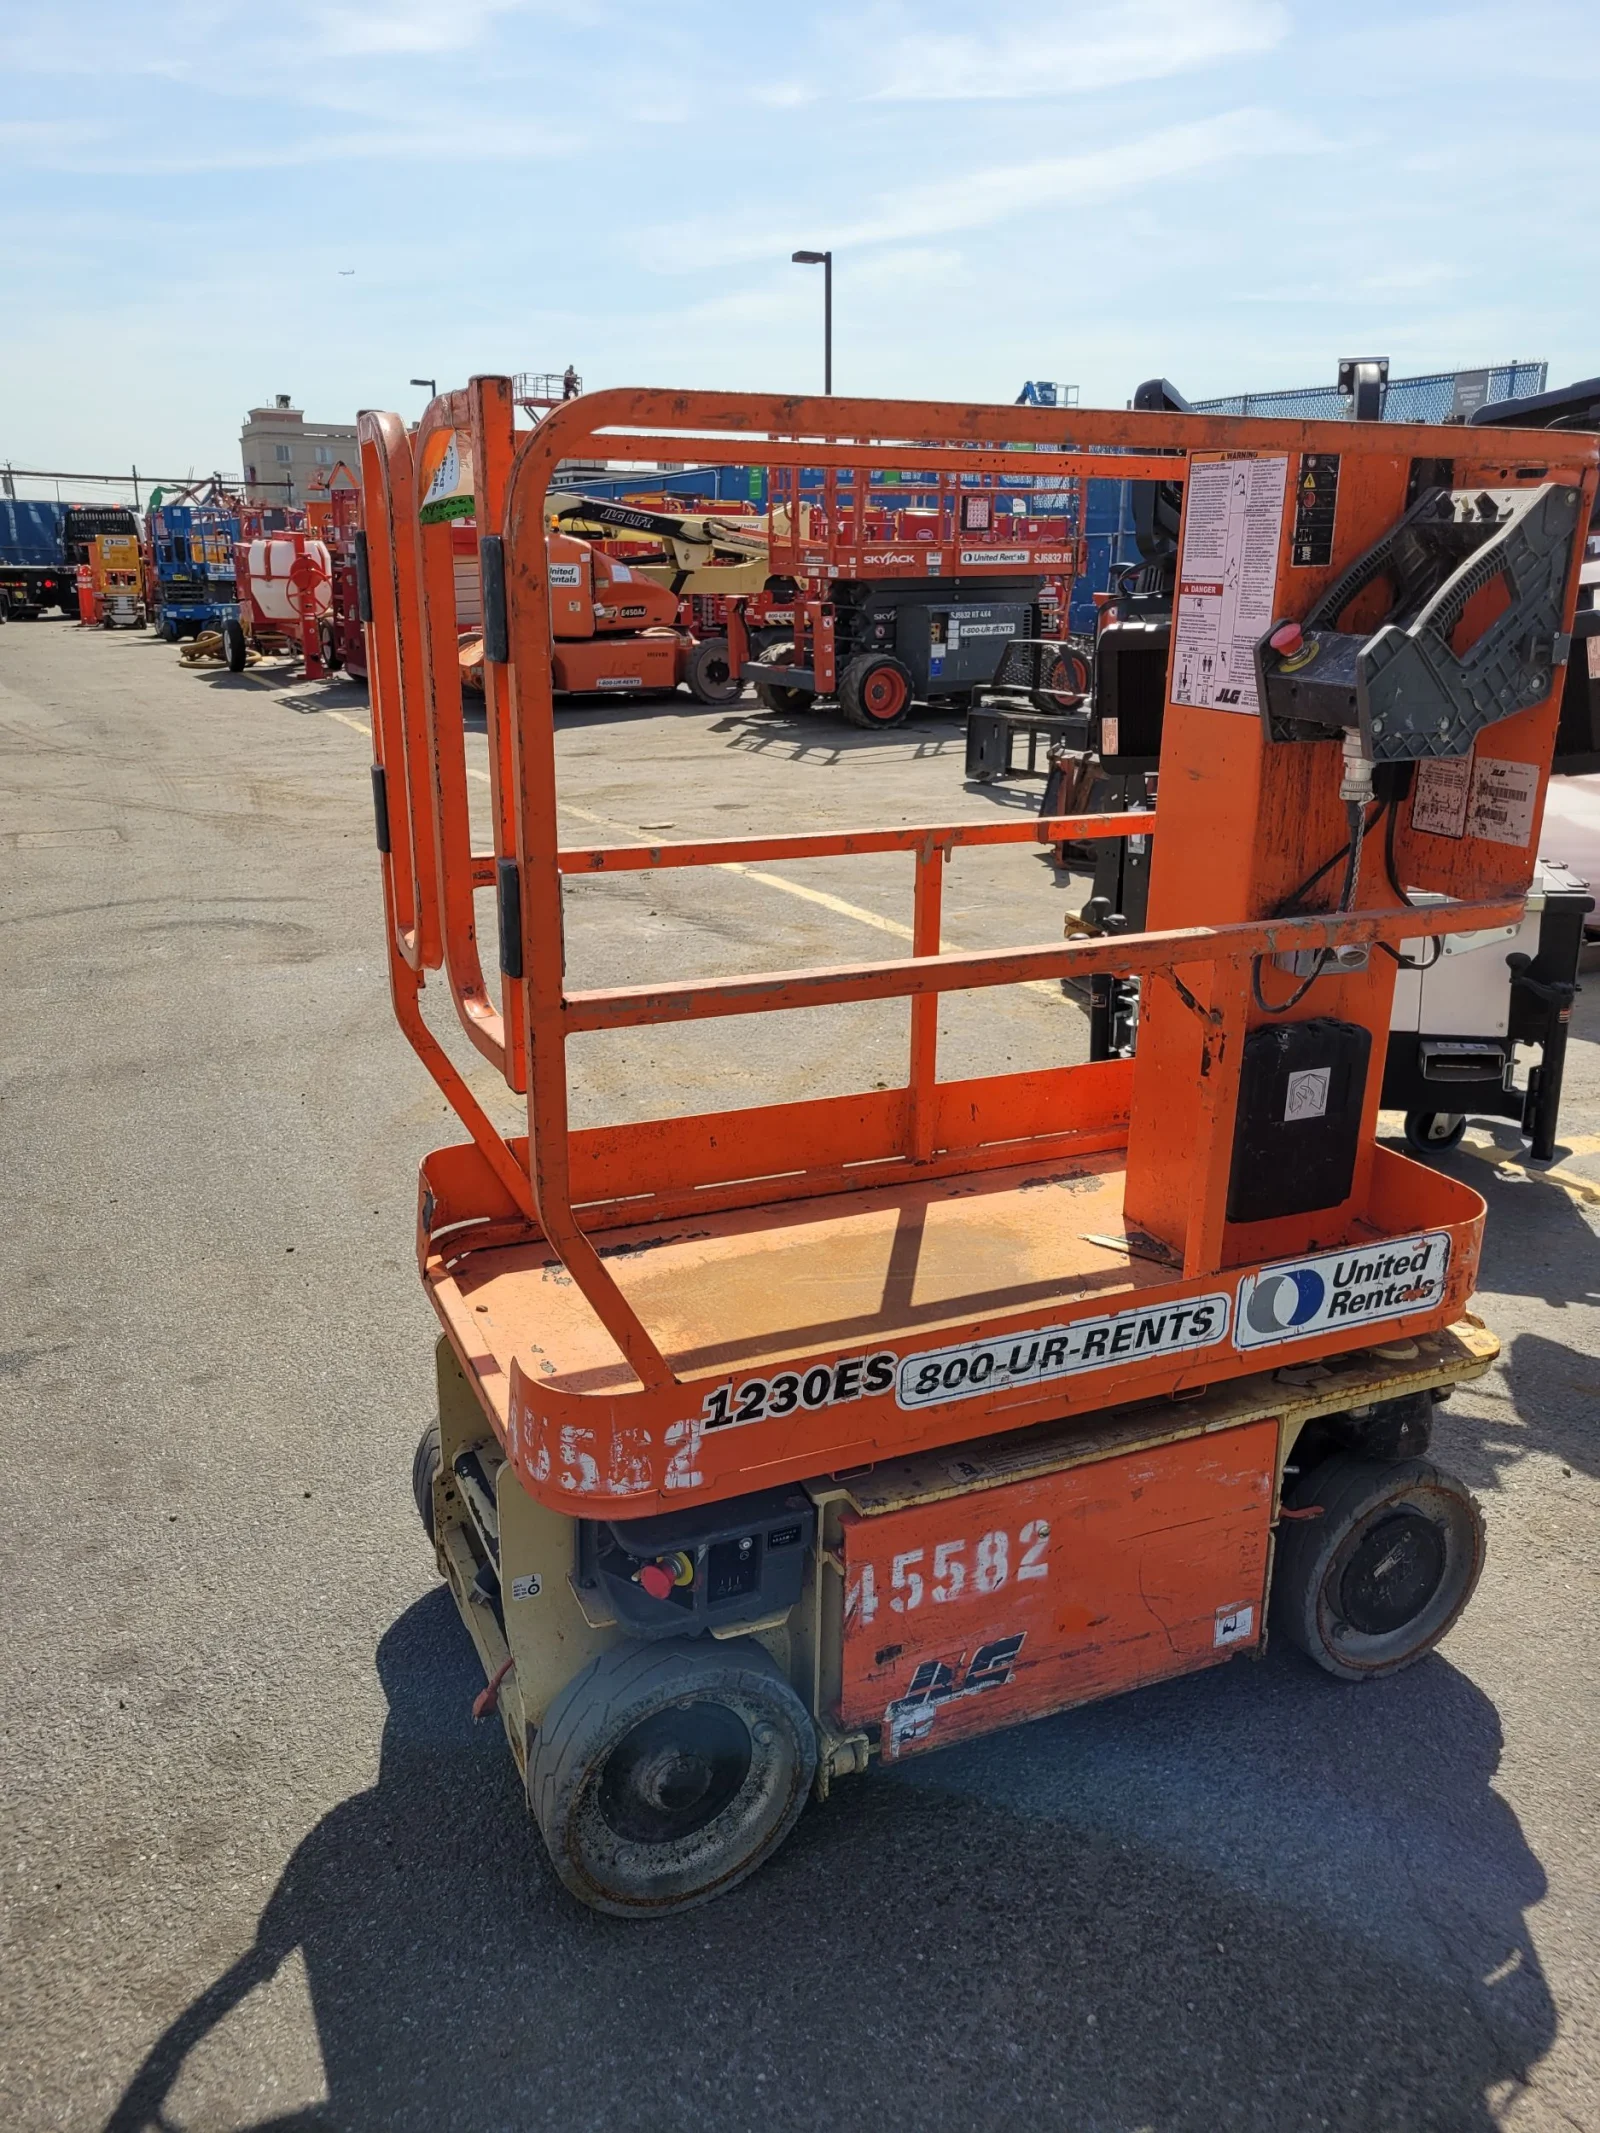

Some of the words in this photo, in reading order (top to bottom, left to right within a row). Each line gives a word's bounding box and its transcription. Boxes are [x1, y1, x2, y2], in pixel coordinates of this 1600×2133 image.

[1227, 451, 1258, 460] WARNING
[600, 508, 627, 523] JLG
[624, 513, 655, 529] LIFT
[863, 551, 915, 565] SKYJACK
[973, 553, 999, 562] United
[550, 567, 574, 575] nited
[550, 575, 577, 584] entals
[1191, 585, 1216, 594] DANGER
[1215, 687, 1242, 705] JLG
[1332, 1244, 1433, 1288] United
[1327, 1274, 1436, 1319] Rentals
[914, 1305, 1215, 1396] 800-UR-RENTS
[703, 1353, 897, 1432] 1230ES
